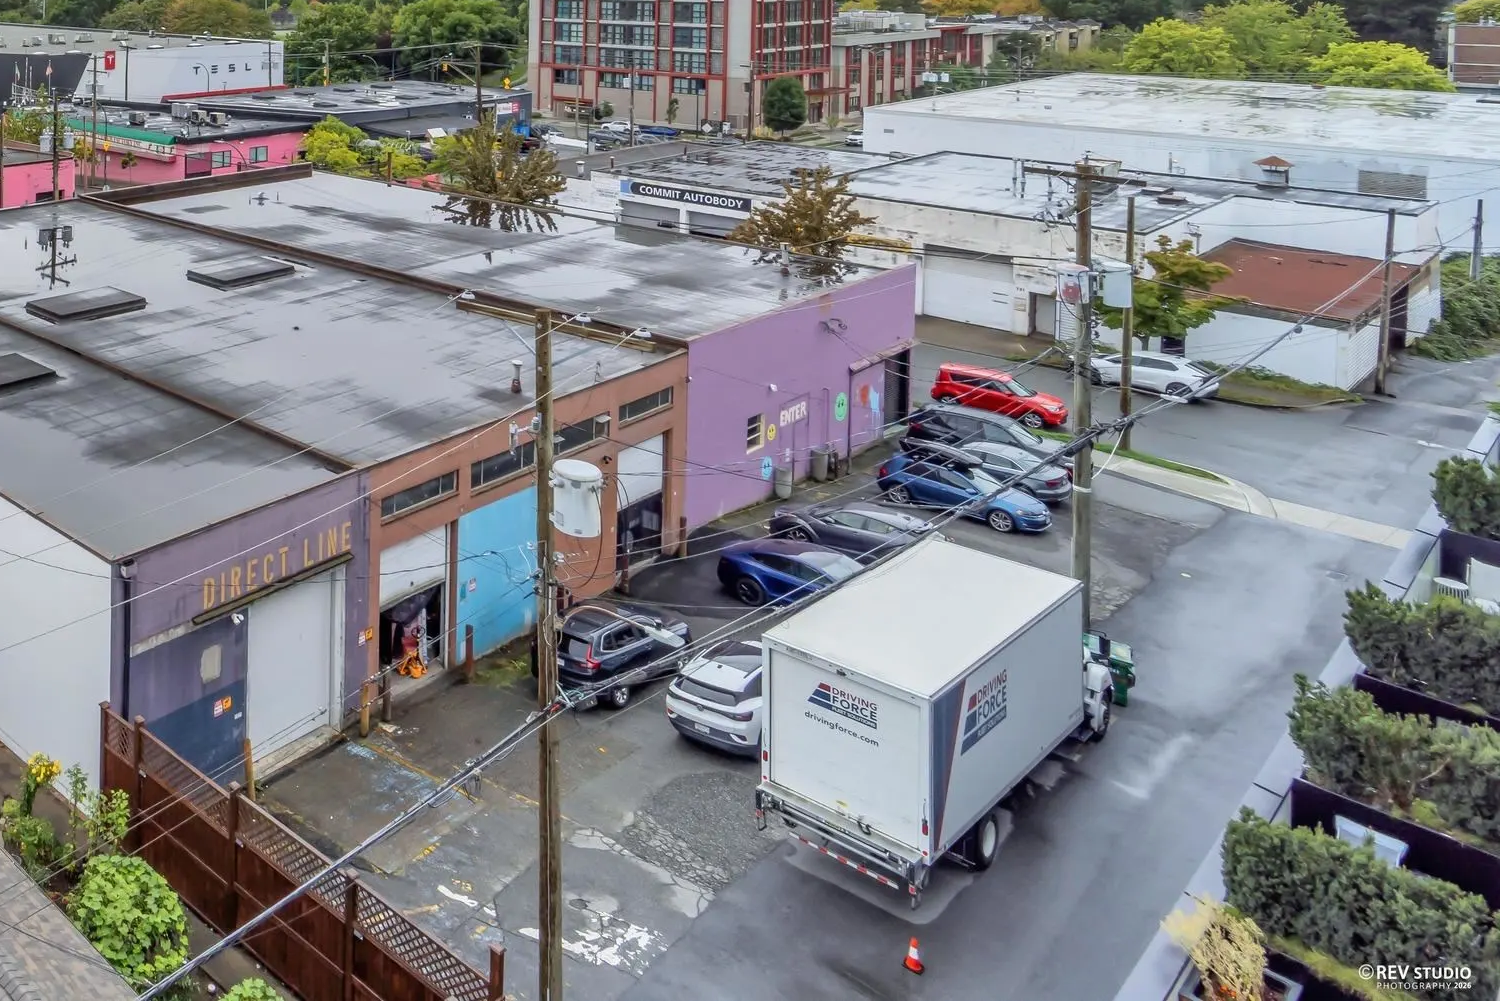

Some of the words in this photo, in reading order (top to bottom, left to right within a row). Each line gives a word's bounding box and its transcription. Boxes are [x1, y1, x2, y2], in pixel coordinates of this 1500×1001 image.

[639, 185, 681, 199] COMMIT
[683, 192, 743, 209] AUTOBODY
[780, 401, 807, 427] ENTER
[203, 546, 289, 610] DIRECT
[303, 521, 352, 567] LINE
[832, 687, 878, 712] DRIVING
[977, 668, 1008, 705] DRIVING
[832, 695, 878, 722] FORCE
[977, 684, 1007, 725] FORCE
[804, 710, 879, 747] drivingforce.com
